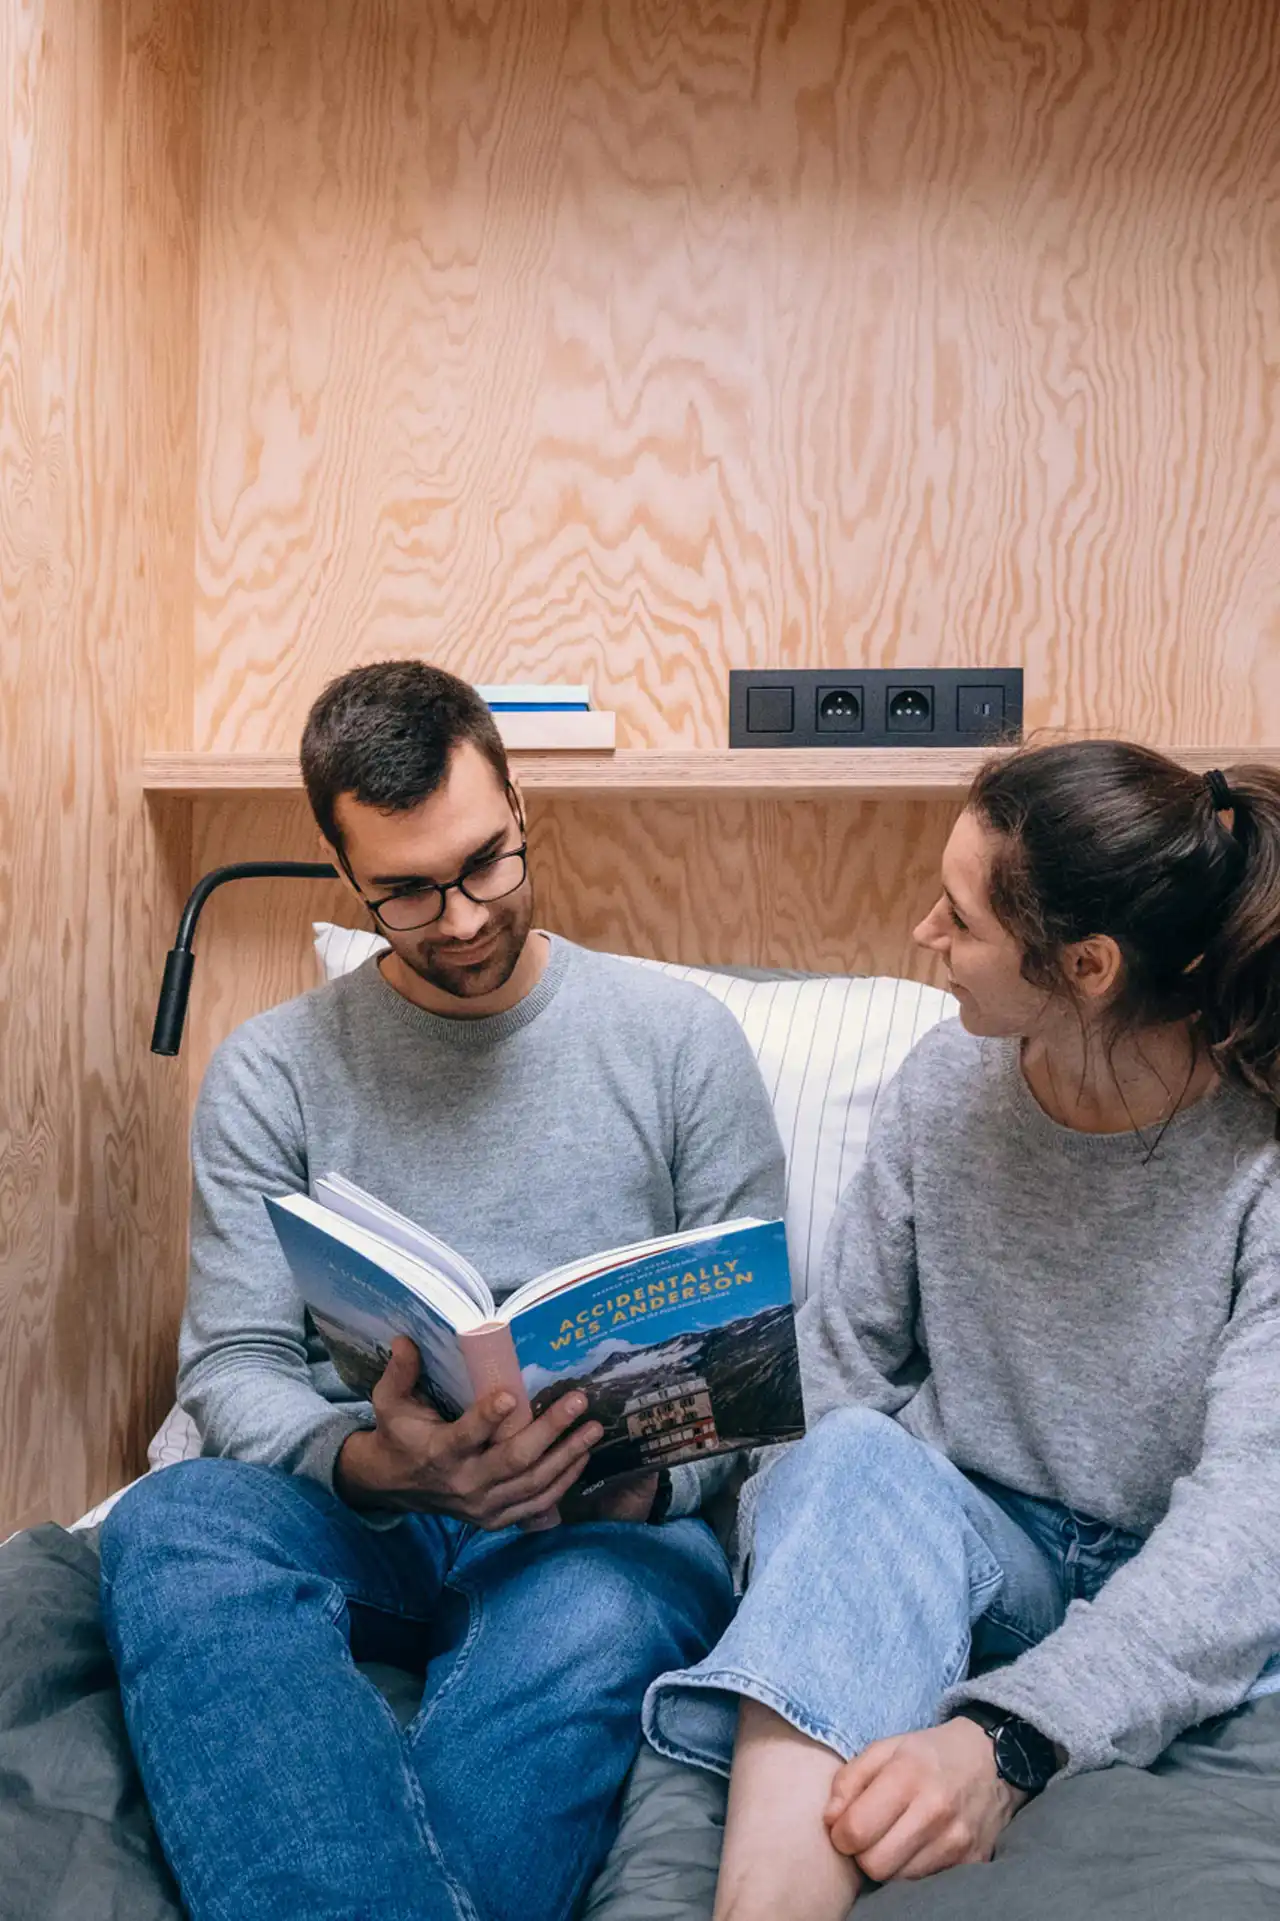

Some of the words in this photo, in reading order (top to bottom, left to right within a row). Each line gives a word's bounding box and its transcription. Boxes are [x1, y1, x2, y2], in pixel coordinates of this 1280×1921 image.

[550, 1322, 600, 1351] WES
[612, 1271, 753, 1324] ANDERSON
[560, 1260, 738, 1332] ACCIDENTALLY
